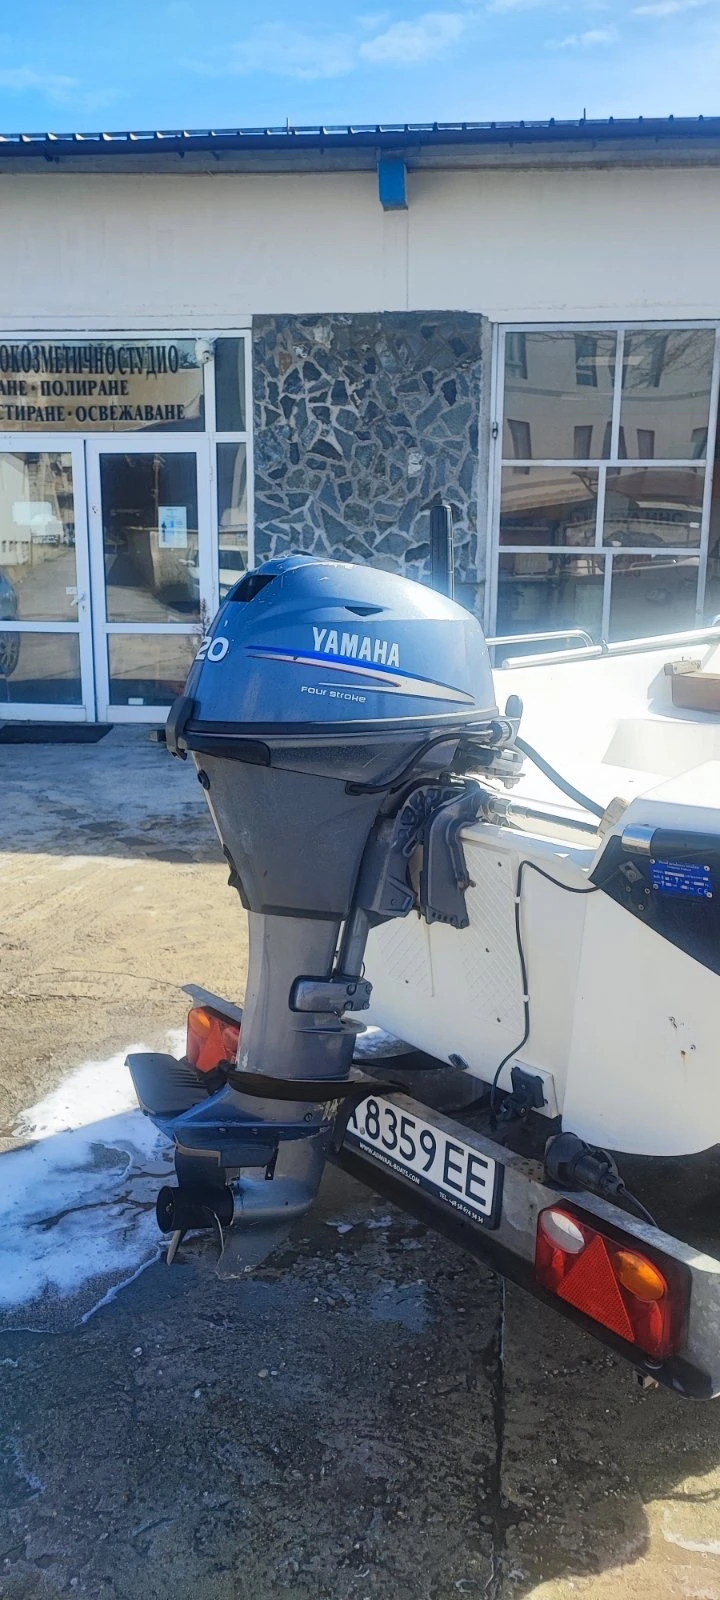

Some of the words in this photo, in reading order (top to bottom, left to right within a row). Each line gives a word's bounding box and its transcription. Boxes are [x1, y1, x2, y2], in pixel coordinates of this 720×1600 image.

[41, 380, 129, 396] ПОЛИРАНЕ
[75, 404, 185, 422] ОСВЕЖАВАНЕ
[195, 636, 229, 662] 20
[312, 626, 400, 668] YAMAHA
